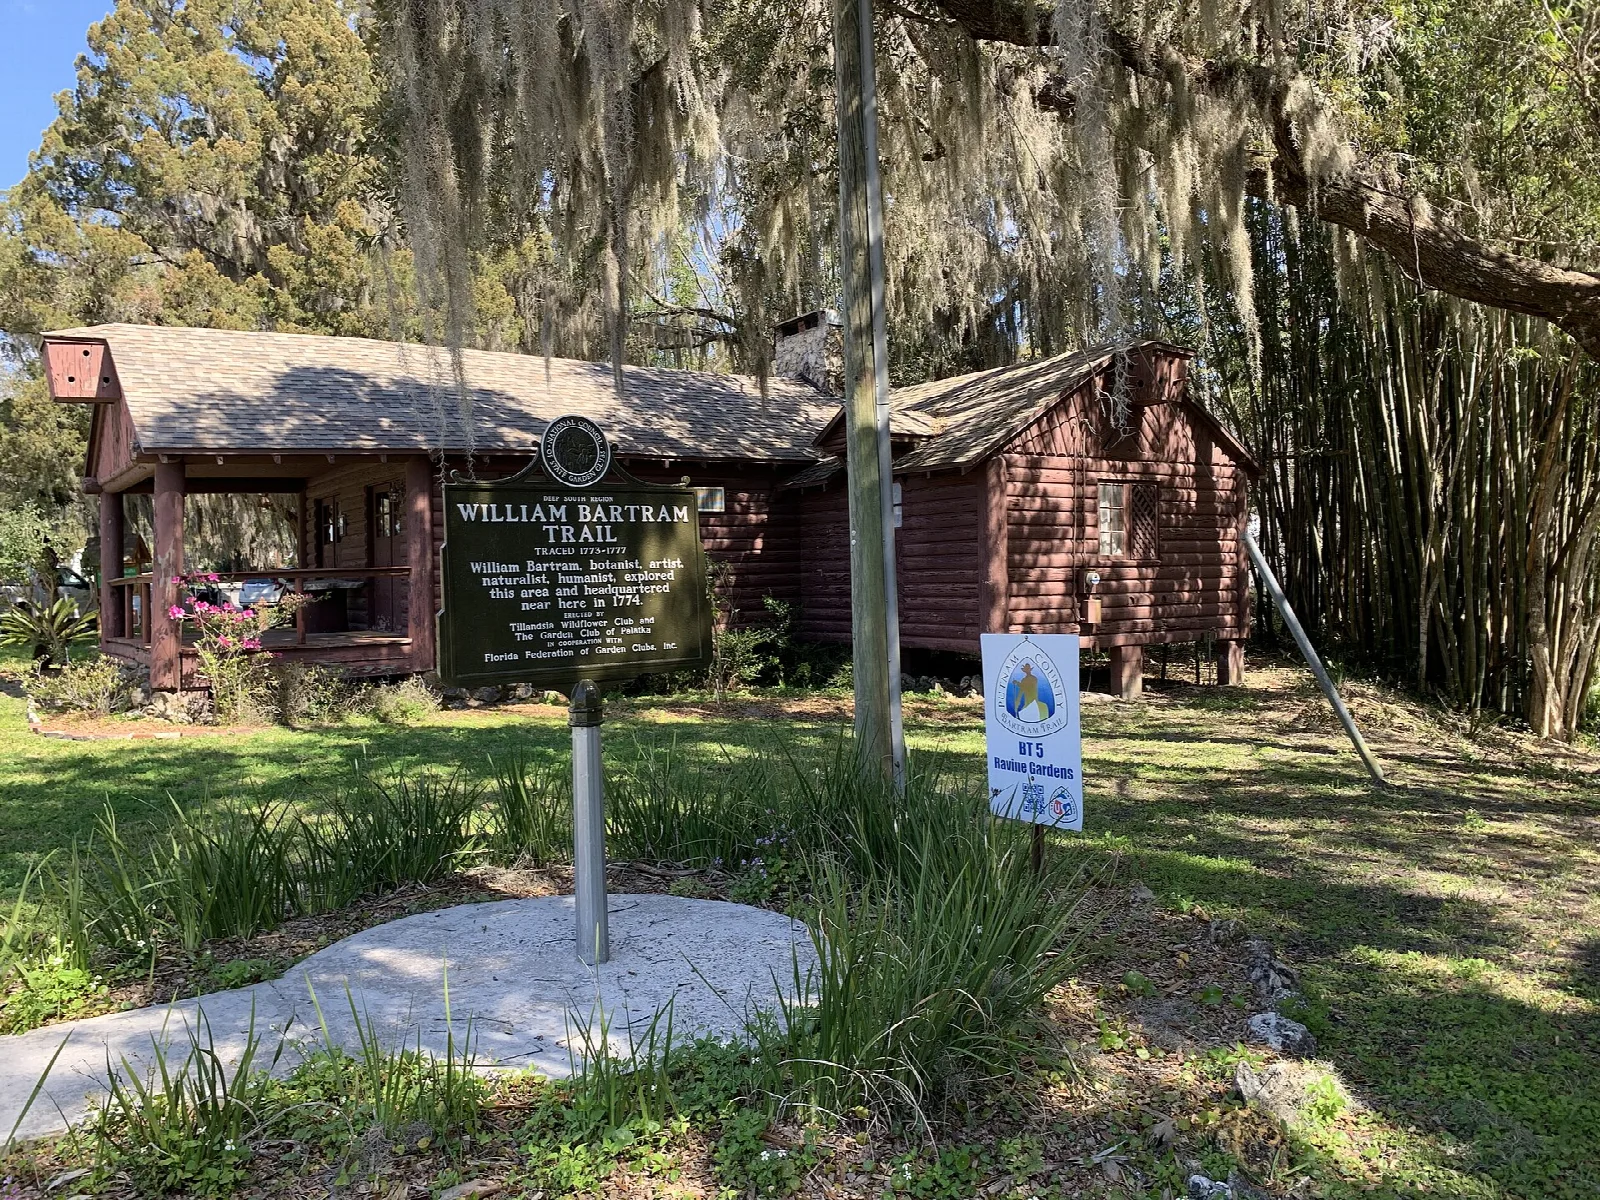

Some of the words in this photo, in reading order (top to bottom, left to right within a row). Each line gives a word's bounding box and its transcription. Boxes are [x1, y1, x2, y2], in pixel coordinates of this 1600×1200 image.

[547, 419, 577, 445] NATIONAL
[577, 421, 604, 445] COUNCIL
[546, 448, 554, 459] OF
[595, 450, 606, 472] CLUBS
[549, 461, 568, 478] STATE
[568, 472, 598, 483] GARDEN
[456, 503, 568, 522] WILLIAM
[578, 504, 689, 523] BARTRAM
[542, 525, 617, 543] TRAIL
[534, 547, 575, 556] TRACED
[580, 546, 627, 555] 1773-1777
[470, 562, 520, 573] William
[482, 574, 550, 586] naturalist,
[558, 573, 616, 583] humanist,
[624, 570, 675, 583] explored
[489, 588, 514, 598] this
[520, 588, 549, 598] area
[555, 585, 577, 595] and
[584, 583, 670, 596] headquartered
[521, 601, 551, 610] near
[558, 598, 586, 608] here
[594, 598, 605, 607] in
[613, 594, 643, 606] 1774.
[509, 622, 554, 631] Tillandsia
[614, 617, 634, 625] Club
[515, 632, 533, 641] The
[540, 631, 573, 639] Garden
[580, 629, 600, 637] Club
[621, 626, 651, 634] Palatka
[484, 653, 519, 662] Florida
[525, 649, 574, 659] Federation
[595, 646, 626, 654] Garden
[998, 655, 1019, 708] PUTNAM
[1035, 653, 1064, 709] COUNTY
[1001, 712, 1039, 734] BARTRAM
[1040, 718, 1064, 732] TRAIL
[1018, 741, 1033, 757] BT
[1036, 742, 1044, 758] 5
[994, 756, 1027, 774] Ravine
[1029, 761, 1074, 780] Gardens
